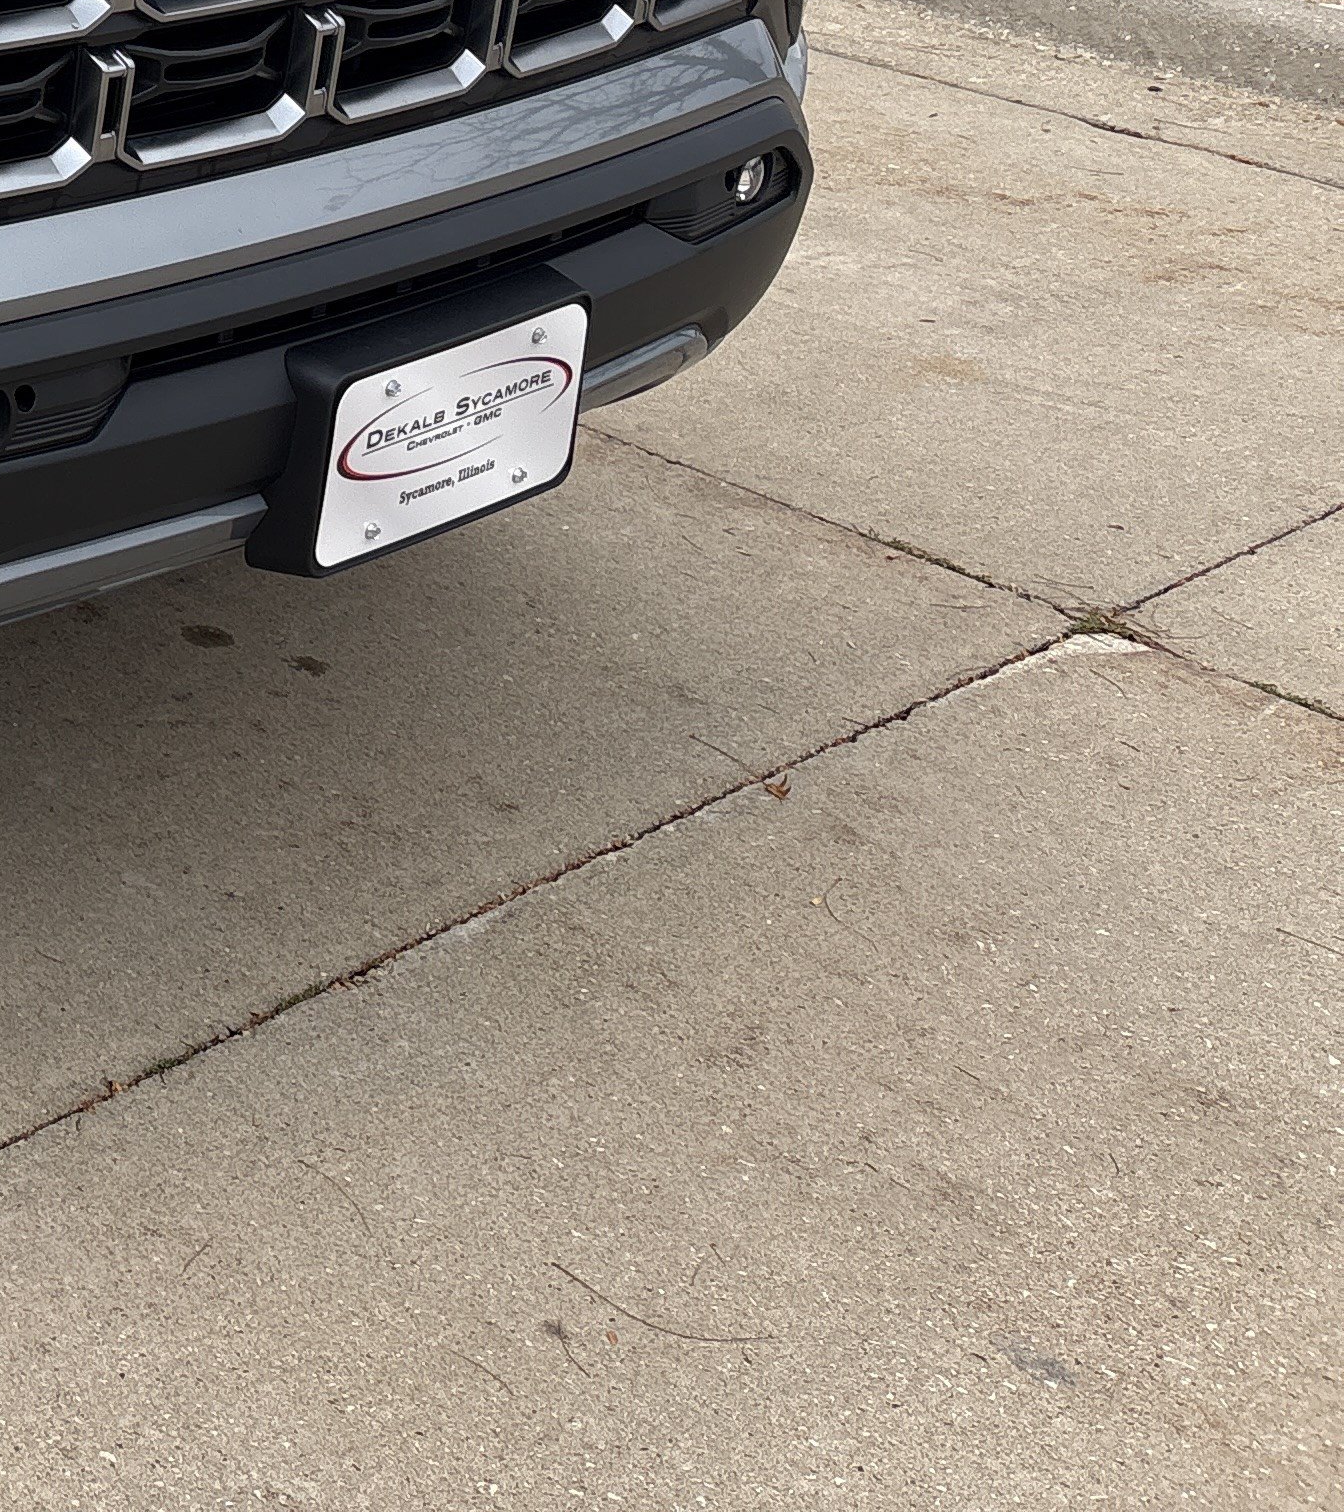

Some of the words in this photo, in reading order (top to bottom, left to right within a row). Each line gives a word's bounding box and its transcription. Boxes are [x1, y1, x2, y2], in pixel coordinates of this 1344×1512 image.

[366, 409, 446, 450] DEKALB
[454, 369, 553, 417] SYCAMORE
[406, 424, 464, 451] CHEVROLET
[473, 407, 503, 426] GMC
[399, 478, 456, 505] Sycamore,
[458, 458, 496, 482] Illinois
